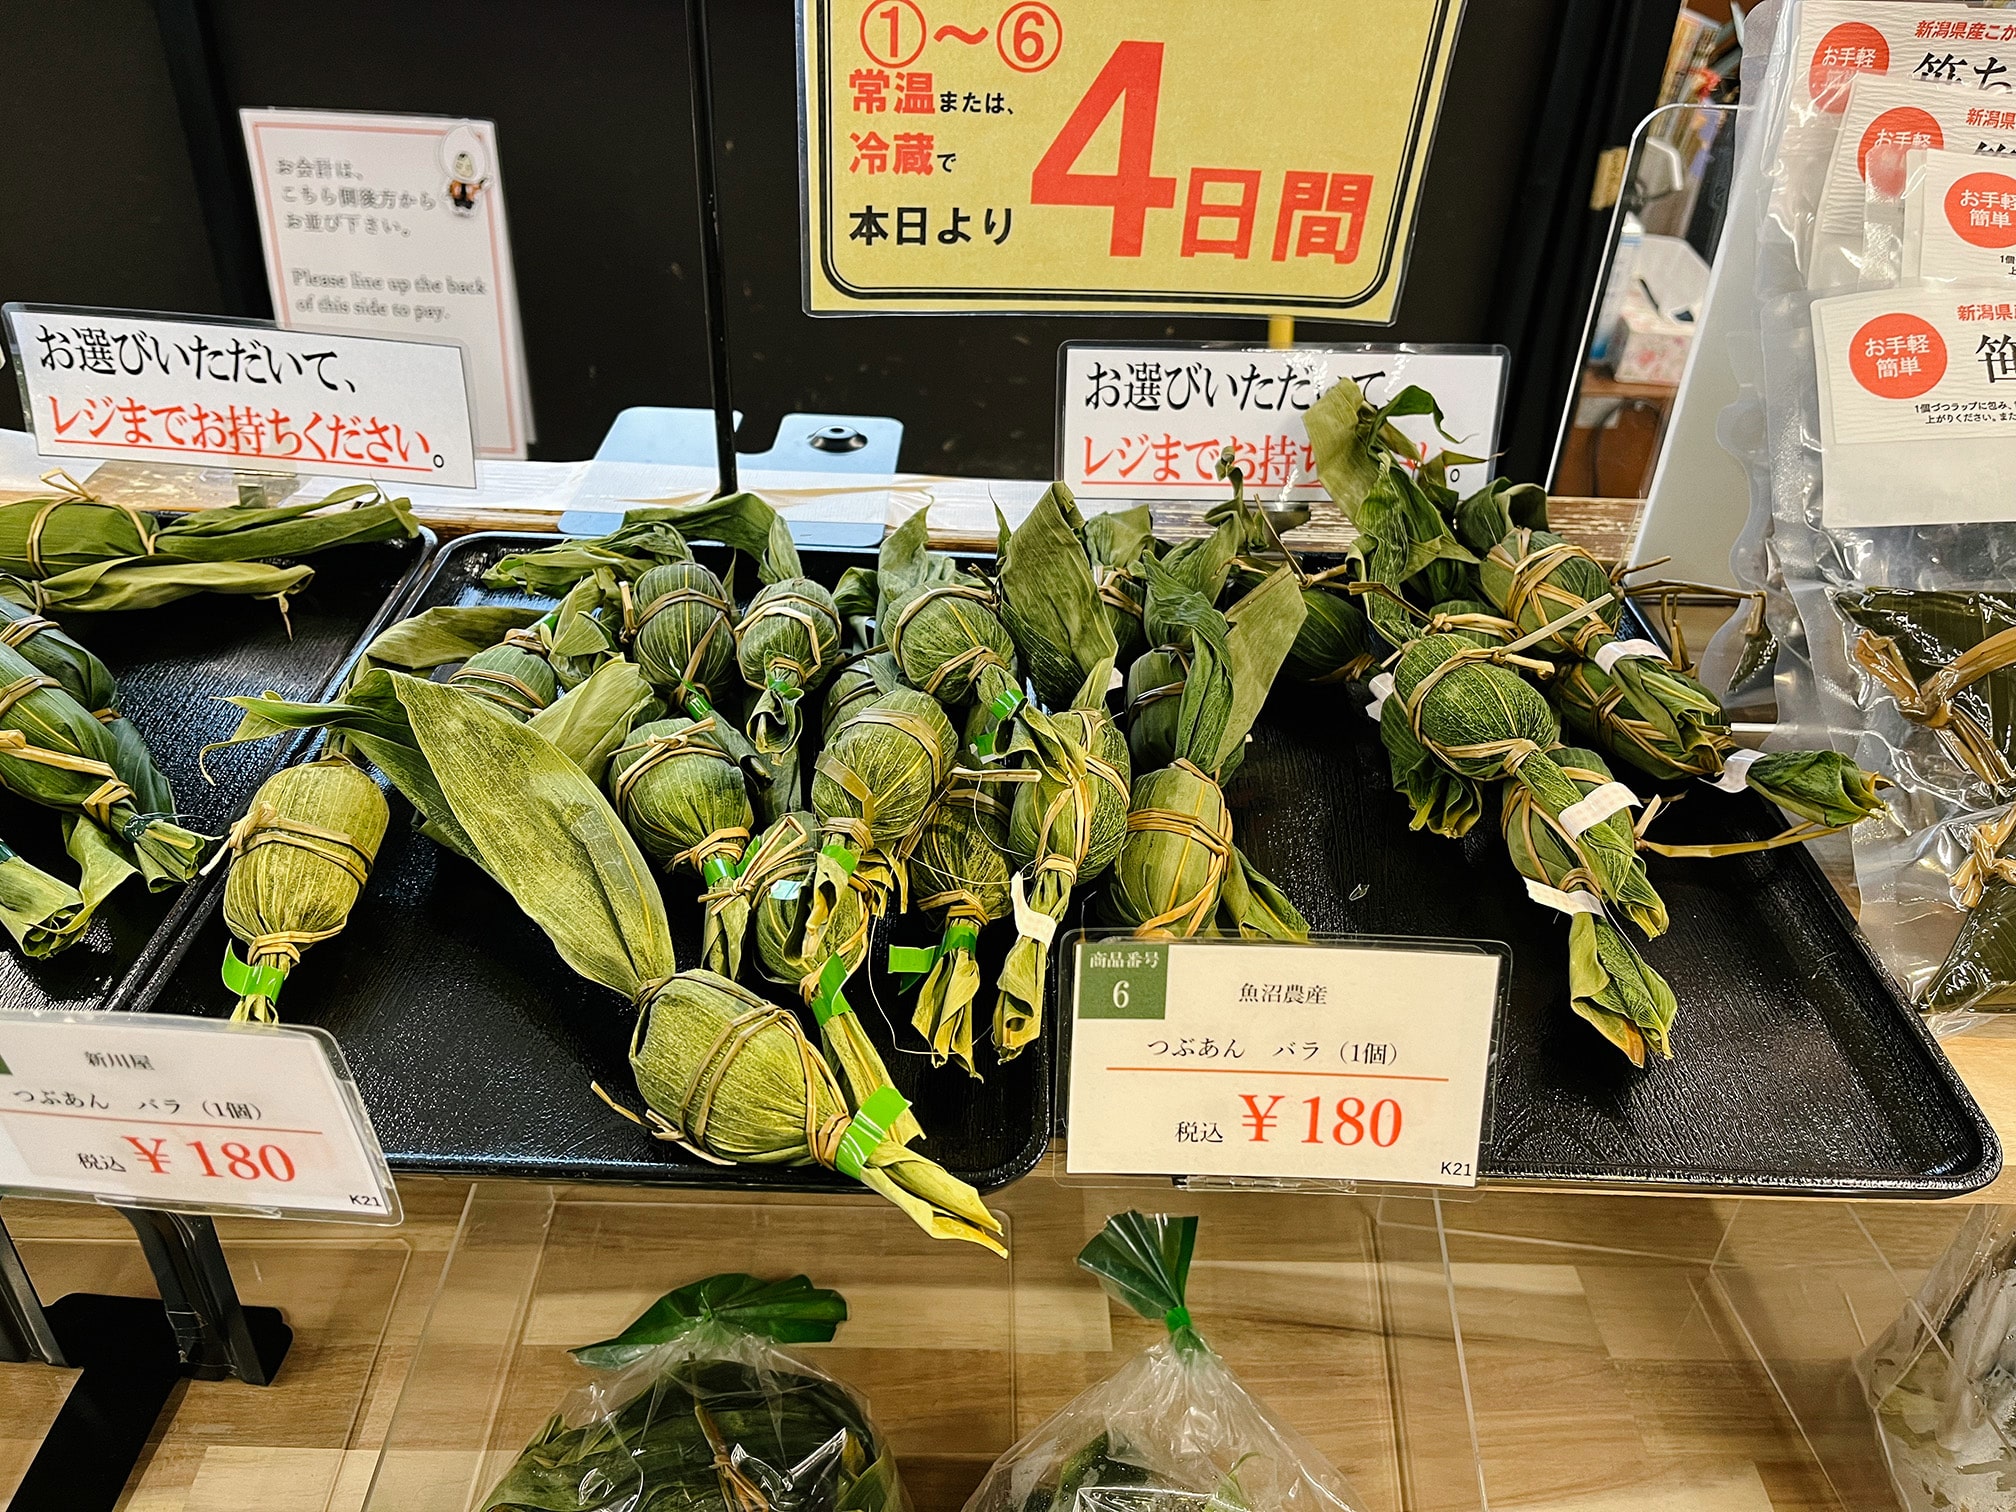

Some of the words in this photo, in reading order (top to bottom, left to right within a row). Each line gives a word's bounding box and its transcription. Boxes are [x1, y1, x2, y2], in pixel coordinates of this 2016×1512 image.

[1822, 45, 1877, 69] お手軽
[1965, 107, 2016, 130] 新潟県
[848, 130, 957, 175] 冷蔵で
[848, 206, 1014, 247] 本日より
[1969, 208, 2012, 228] 簡単
[291, 268, 348, 288] Please
[350, 270, 385, 289] line
[387, 277, 411, 296] up
[414, 274, 444, 293] the
[446, 275, 488, 295] back
[295, 294, 315, 312] of
[317, 296, 351, 314] this
[353, 298, 388, 316] side
[391, 301, 411, 316] to
[414, 303, 450, 322] pay.
[1957, 304, 2016, 321] 新潟県
[1865, 334, 1930, 358] お手軽
[38, 324, 356, 393] お選びいただいて、
[1875, 356, 1921, 379] 簡単
[49, 396, 445, 469] レジまでお持ちください。
[1089, 951, 1160, 969] 商品番号
[1112, 980, 1130, 1009] 6
[1238, 983, 1328, 1006] 魚沼農産
[1147, 1037, 1246, 1060] つぶあん
[84, 1051, 155, 1071] 新川屋
[13, 1089, 109, 1110] つぶあん
[1174, 1120, 1223, 1144] 税込
[77, 1152, 126, 1173] 税込
[1441, 1161, 1472, 1178] K21
[349, 1194, 382, 1208] K21
